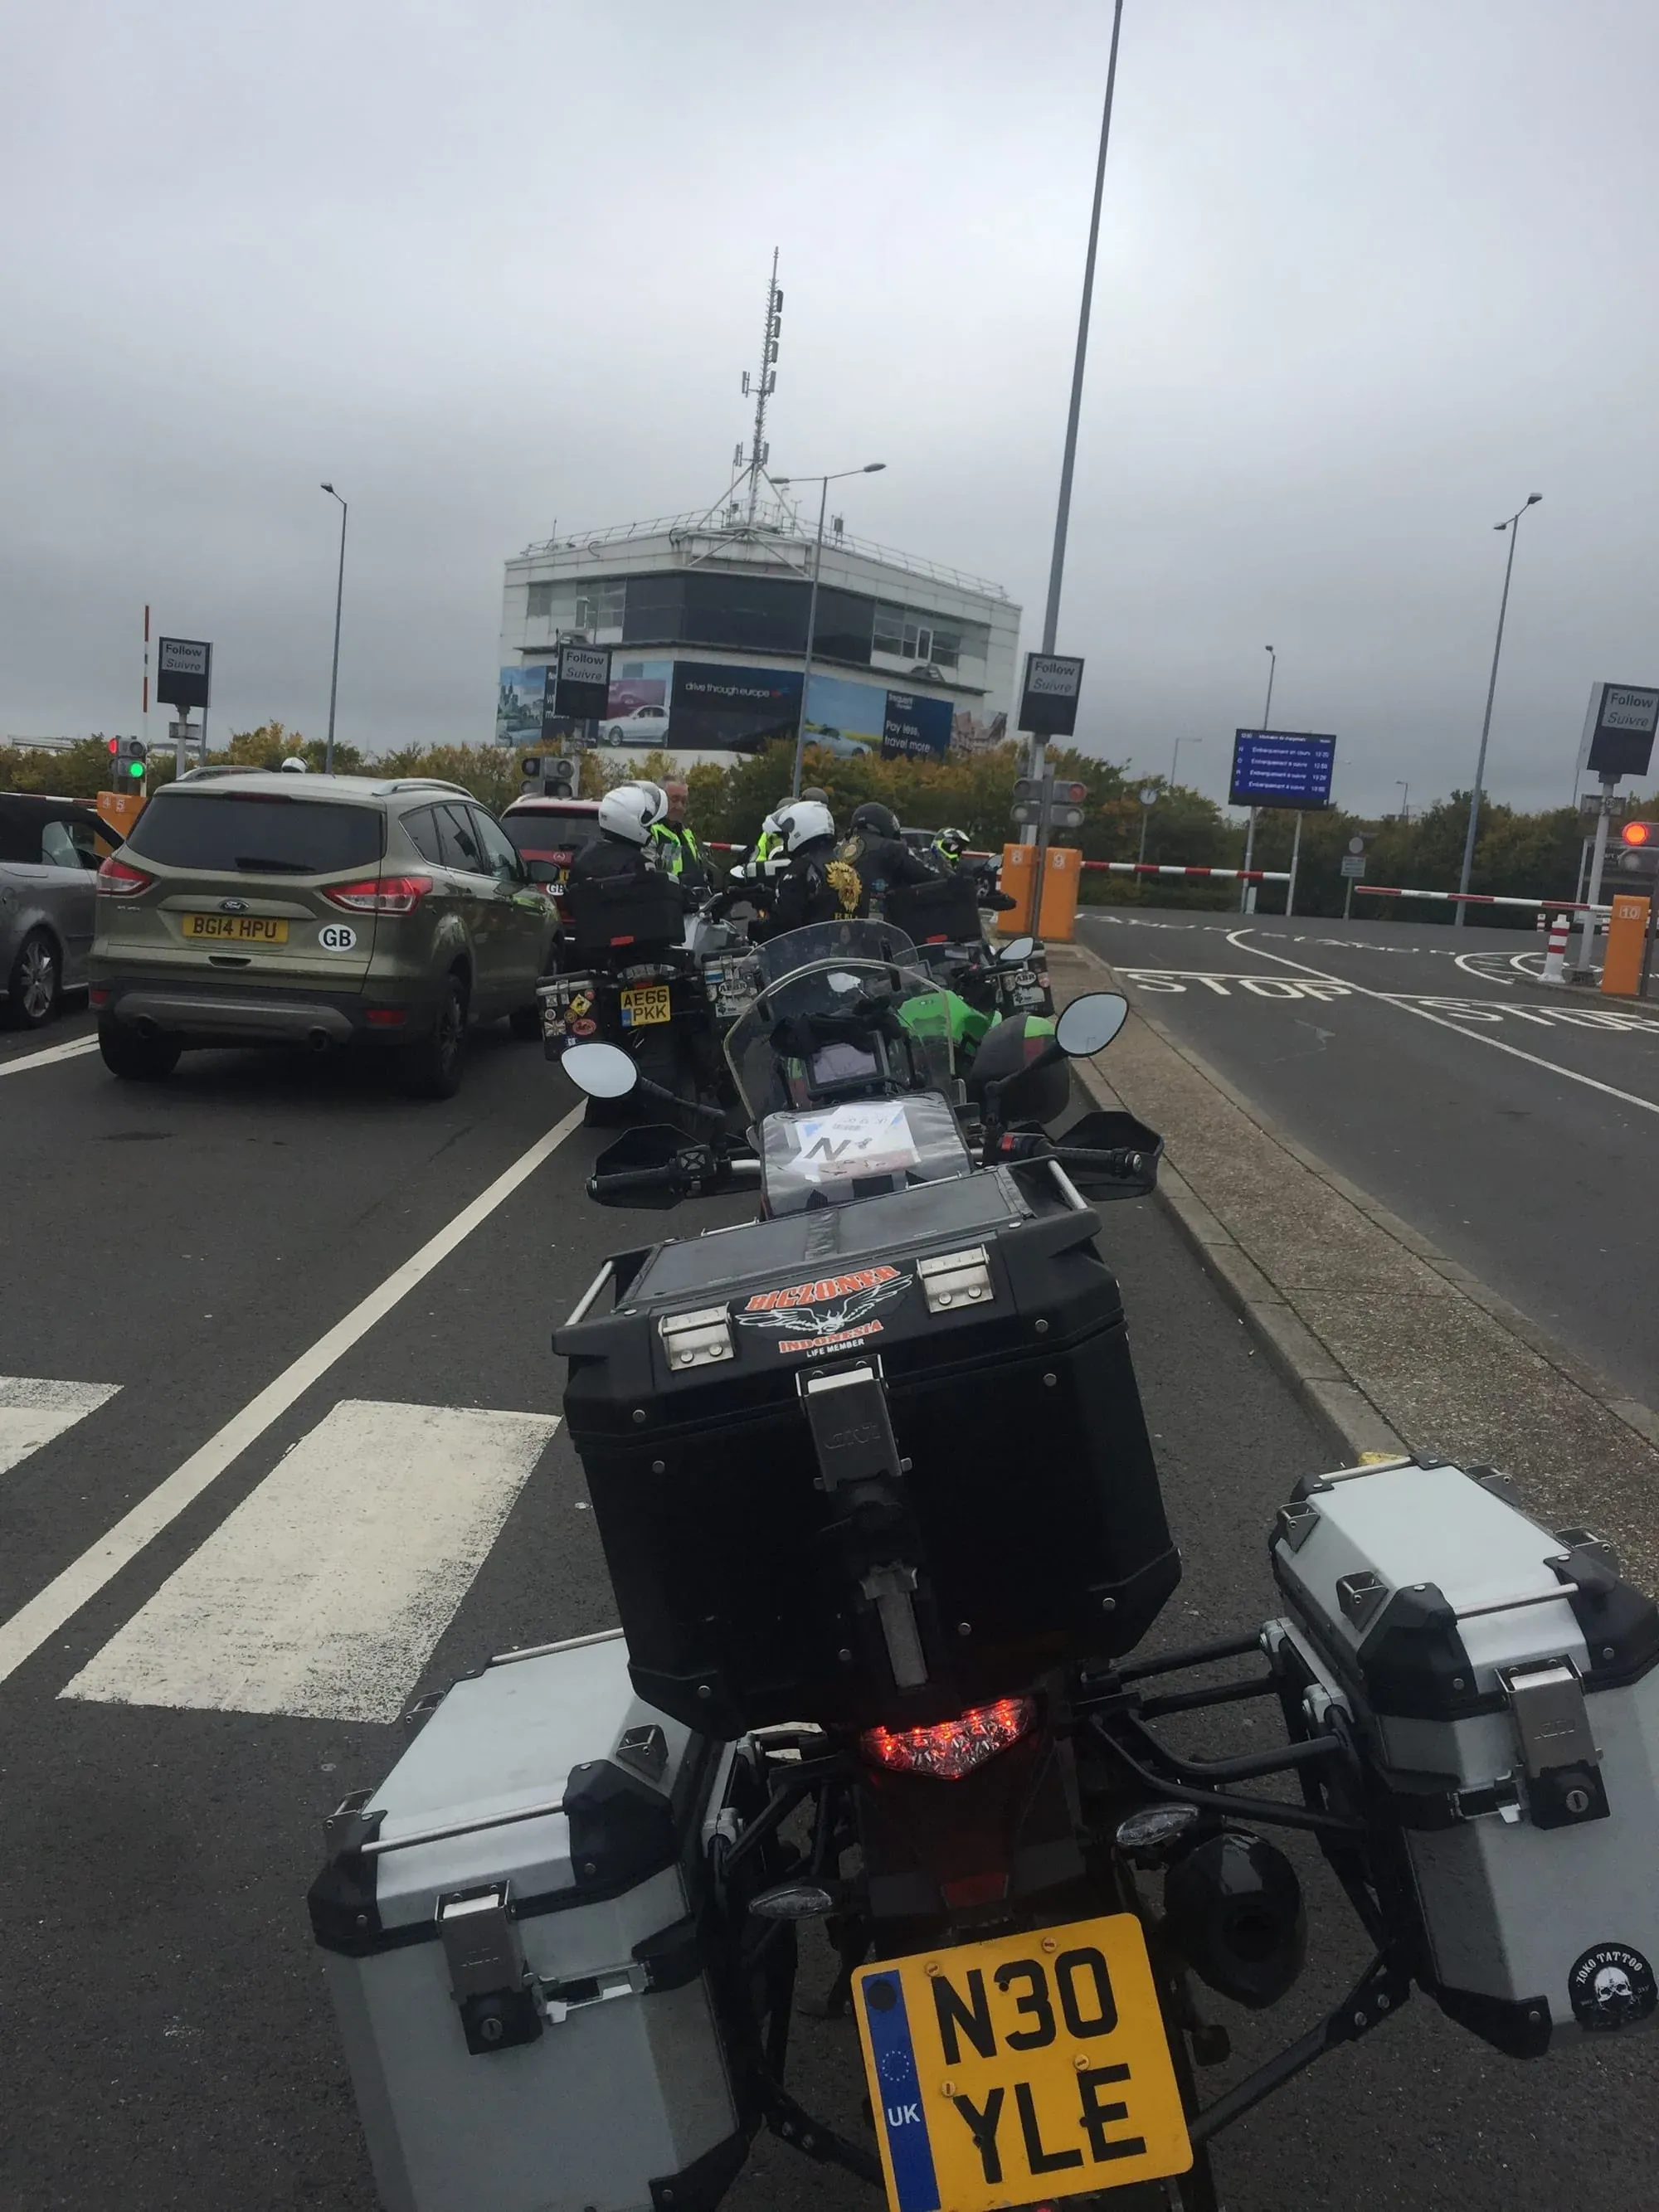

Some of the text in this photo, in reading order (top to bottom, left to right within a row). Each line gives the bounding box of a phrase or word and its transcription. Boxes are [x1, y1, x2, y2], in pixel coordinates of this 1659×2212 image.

[166, 644, 202, 657] Follow
[567, 651, 604, 664] Follow
[167, 659, 201, 671] Suivre
[1035, 661, 1075, 676] Follow
[567, 667, 602, 681] Suivre
[685, 682, 770, 698] drive through europe
[1034, 678, 1072, 693] Suivre
[1611, 693, 1653, 708] Follow
[886, 721, 902, 735] Pay
[1608, 712, 1649, 727] Suivre
[884, 736, 931, 753] travel more
[103, 796, 110, 809] 4
[224, 900, 241, 910] Ford
[1622, 907, 1639, 919] 10
[192, 916, 277, 939] BG14 HPU
[323, 928, 352, 947] GB
[1127, 974, 1352, 1002] STOP
[624, 989, 668, 1009] AE66
[633, 1004, 667, 1023] PKK
[1418, 999, 1659, 1034] STOP
[803, 1136, 853, 1161] N
[778, 1319, 884, 1354] INDONESIA
[805, 1337, 865, 1359] LIFE MEMBER
[1575, 1951, 1644, 1985] ZOKO TATTOO
[931, 1946, 1119, 2066] N30
[887, 2103, 922, 2127] UK
[952, 2062, 1148, 2185] YLE
